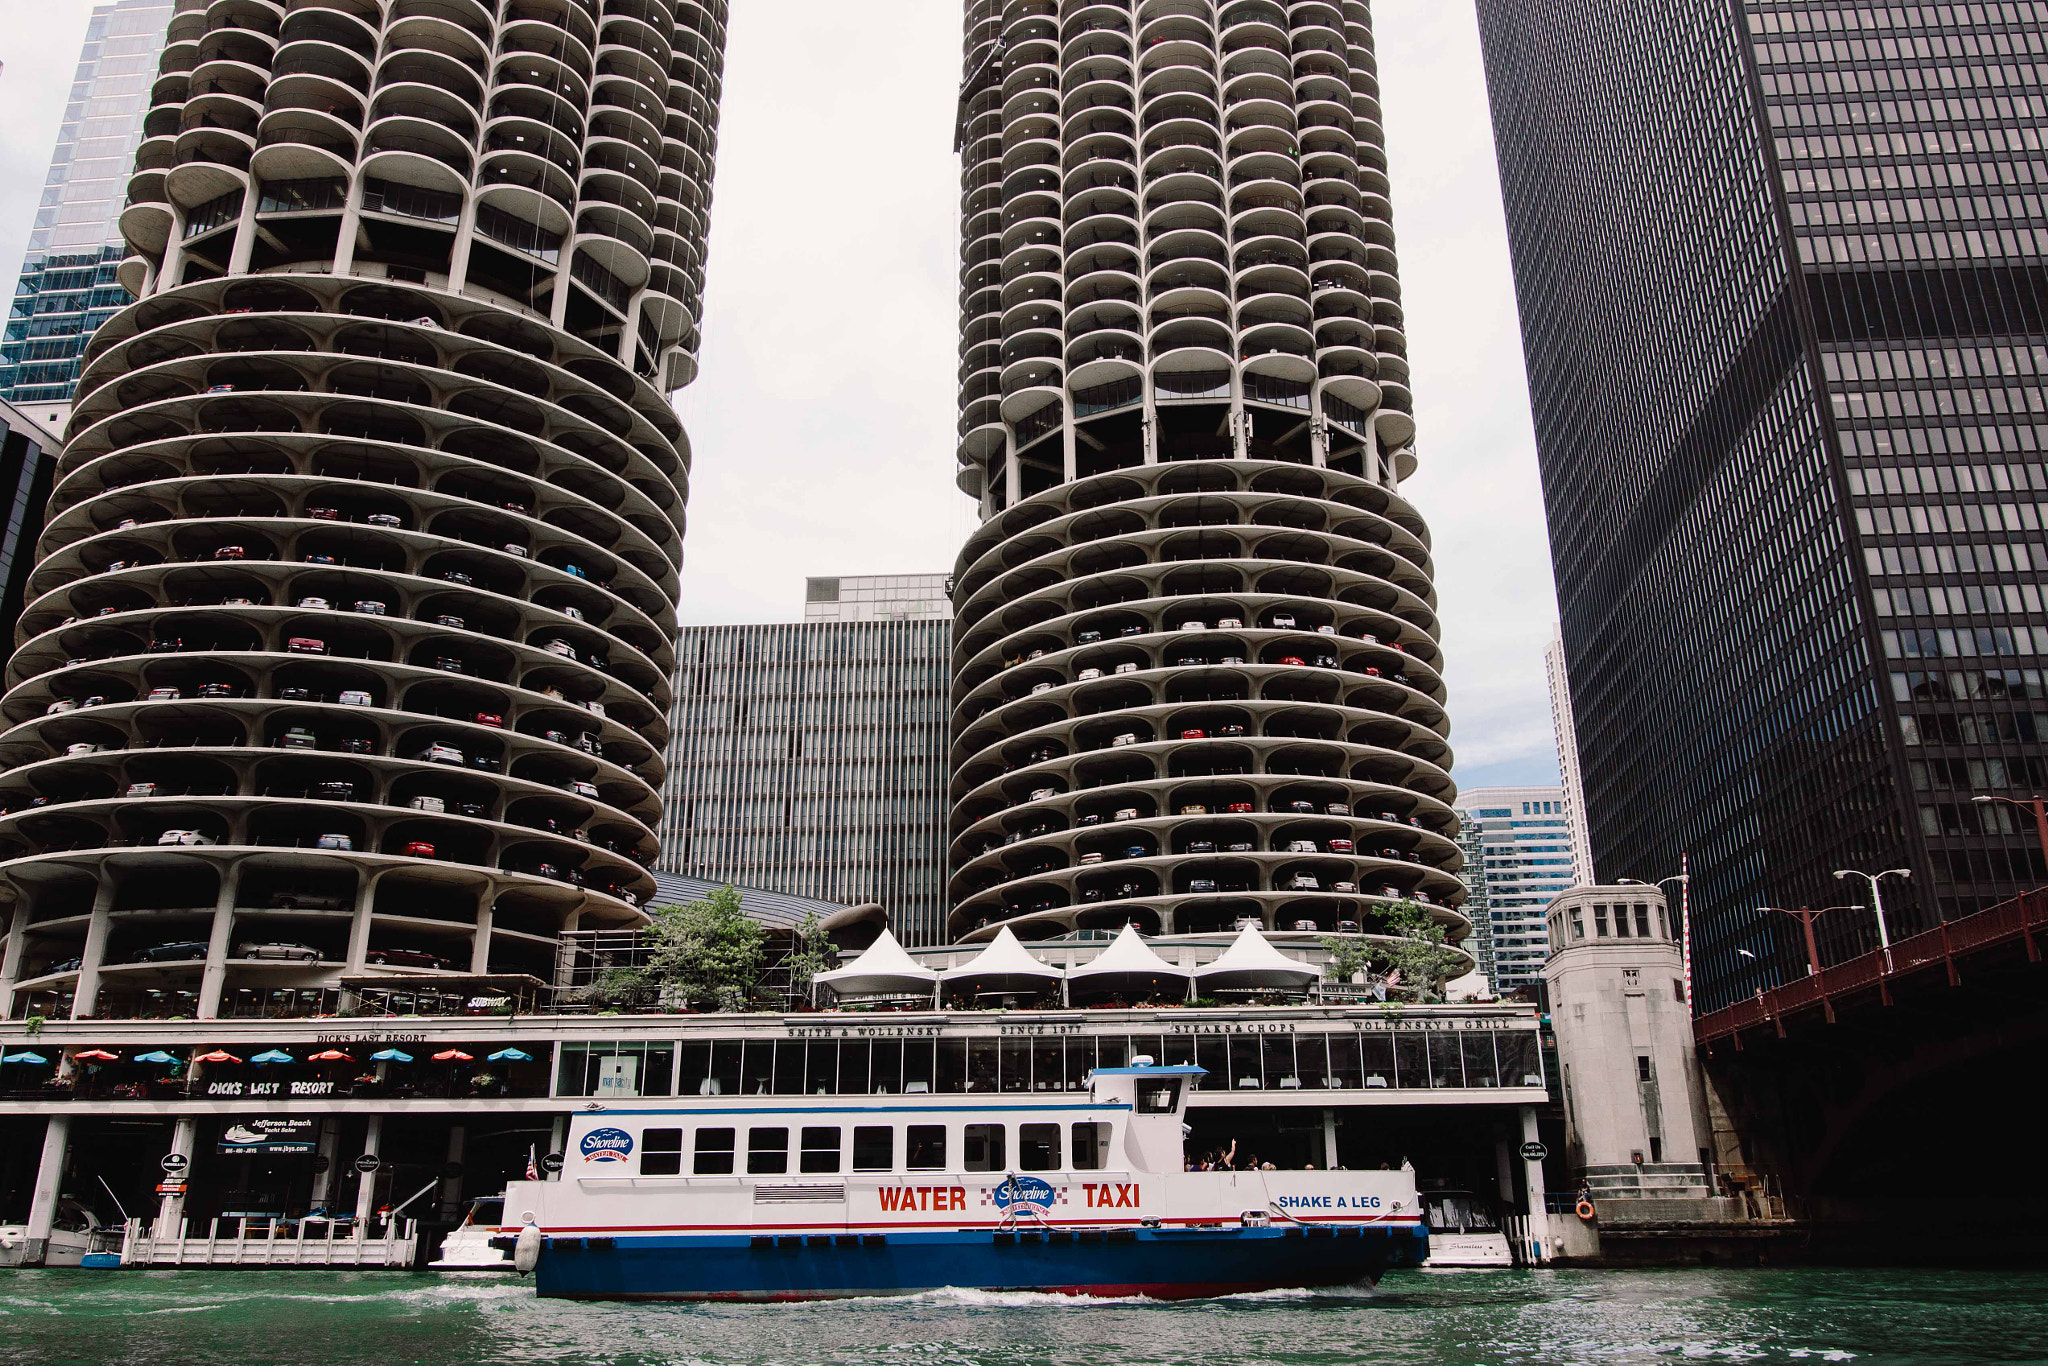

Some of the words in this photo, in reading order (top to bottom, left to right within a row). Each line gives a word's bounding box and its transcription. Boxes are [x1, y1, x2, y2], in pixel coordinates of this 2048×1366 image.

[468, 996, 511, 1007] SUBWAY
[1001, 1026, 1044, 1035] SINCE
[1053, 1026, 1082, 1034] 1977
[1353, 1021, 1454, 1030] WOLLENSKY'S
[1465, 1020, 1510, 1029] GRILL
[788, 1028, 831, 1037] SMITH
[842, 1028, 849, 1037] &
[857, 1027, 943, 1037] WOLLENSKY
[317, 1034, 351, 1043] DICK'S
[355, 1034, 381, 1042] LAST
[386, 1034, 427, 1042] RESORT
[208, 1082, 242, 1095] DICK'S
[250, 1082, 280, 1095] LAST
[290, 1081, 334, 1095] RESORT
[252, 1120, 287, 1128] Jefferson
[583, 1135, 629, 1149] Shoreline
[998, 1185, 1050, 1200] Shoreline
[1082, 1183, 1140, 1208] TAXI
[878, 1186, 966, 1211] WATER
[1279, 1196, 1332, 1208] SHAKE
[1337, 1197, 1347, 1207] A
[1351, 1196, 1381, 1208] LEG
